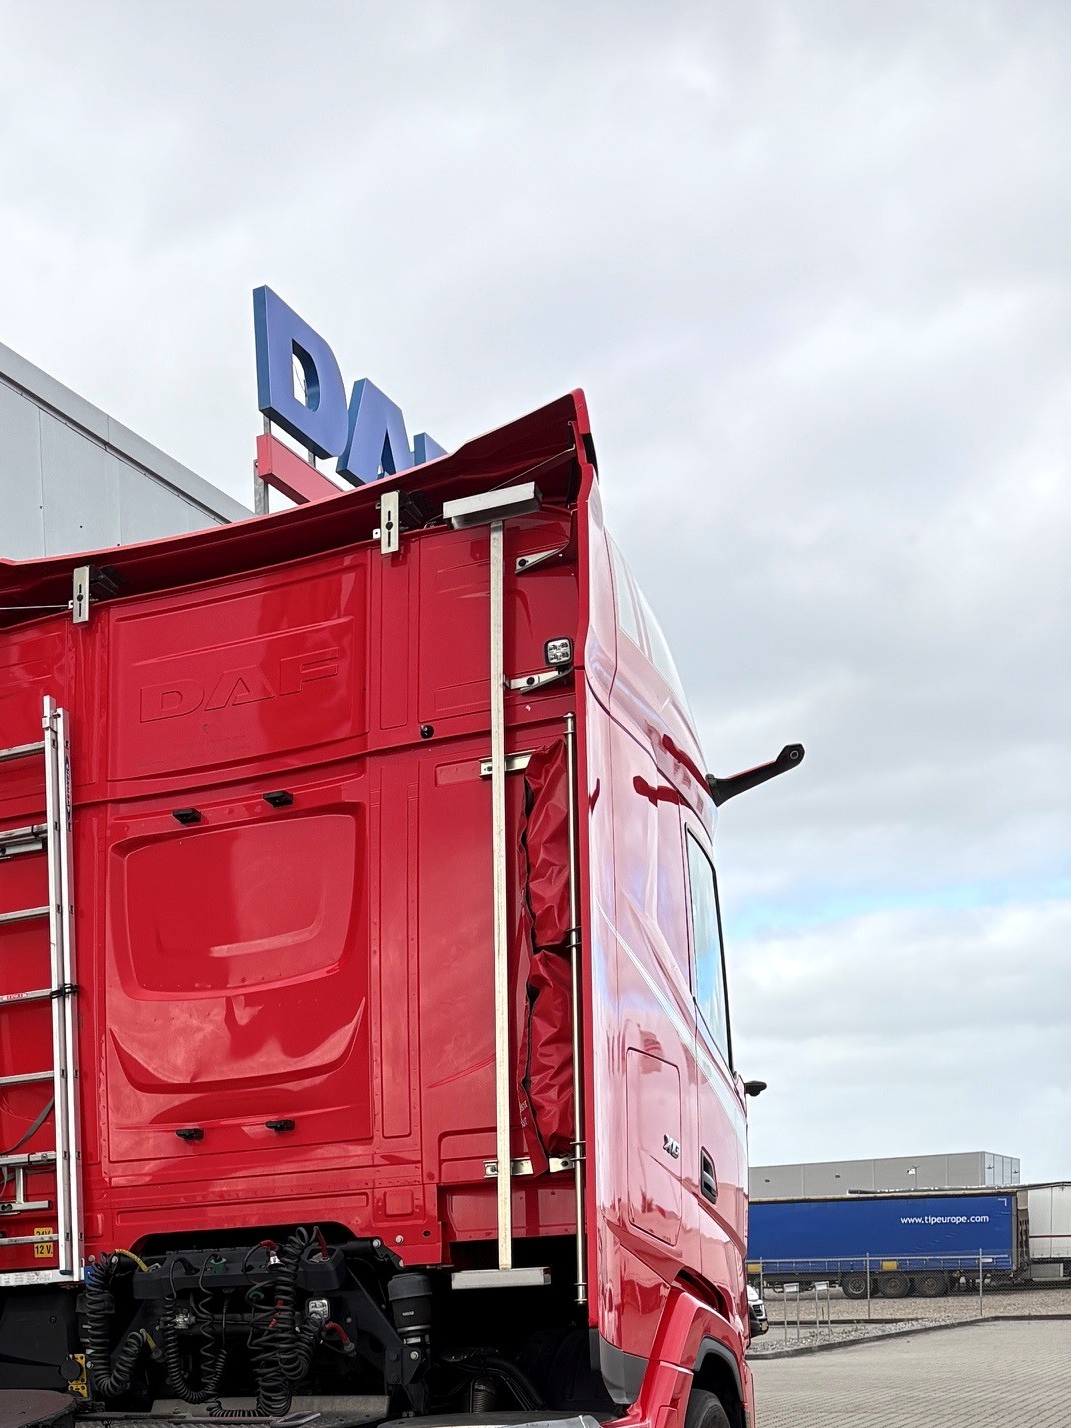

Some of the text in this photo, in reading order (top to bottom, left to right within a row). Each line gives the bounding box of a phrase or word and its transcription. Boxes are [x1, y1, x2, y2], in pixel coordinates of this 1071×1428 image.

[253, 285, 448, 487] DA
[140, 646, 340, 724] DAF
[900, 1214, 990, 1226] www.tipeurope.com
[36, 1244, 45, 1255] 12
